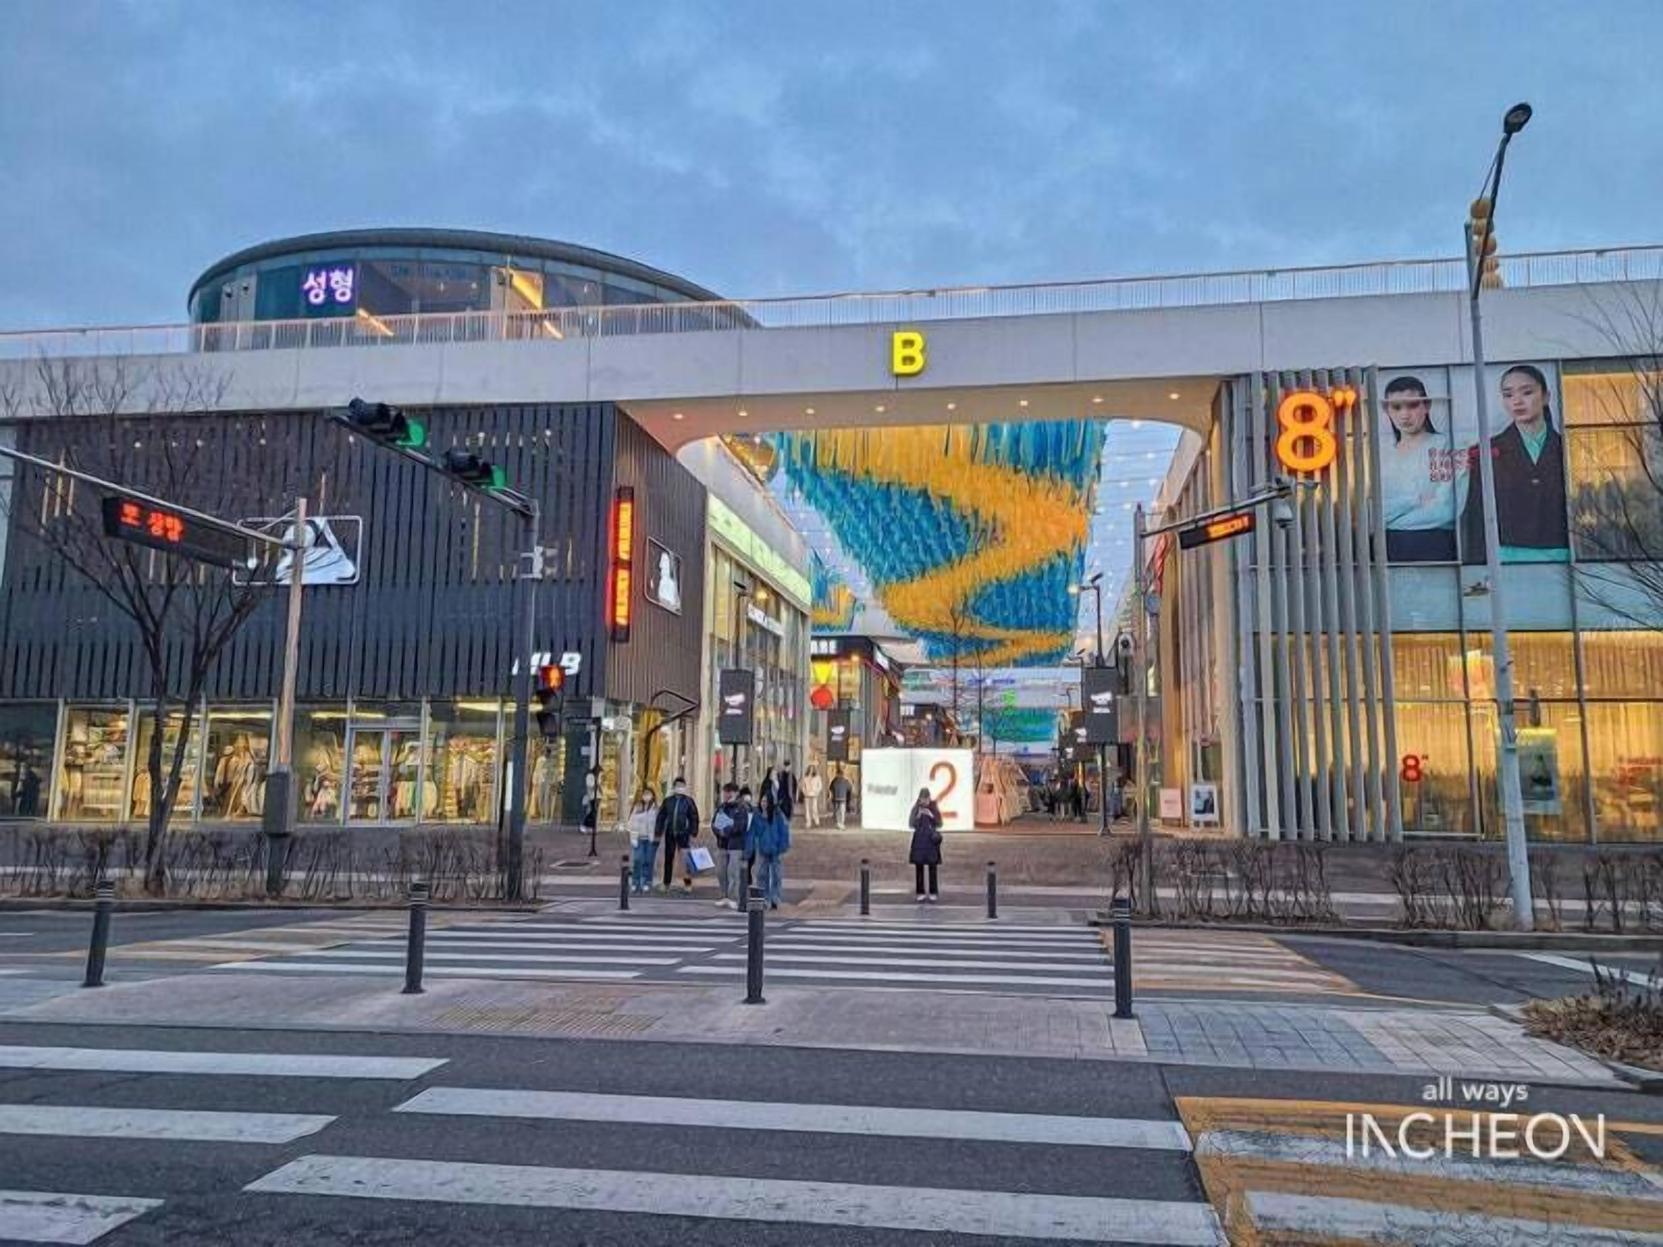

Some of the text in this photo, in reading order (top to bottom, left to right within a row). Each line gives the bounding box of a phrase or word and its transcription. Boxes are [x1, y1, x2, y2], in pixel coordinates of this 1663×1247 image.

[303, 269, 353, 304] 성형
[893, 331, 924, 375] B
[929, 761, 957, 819] 2
